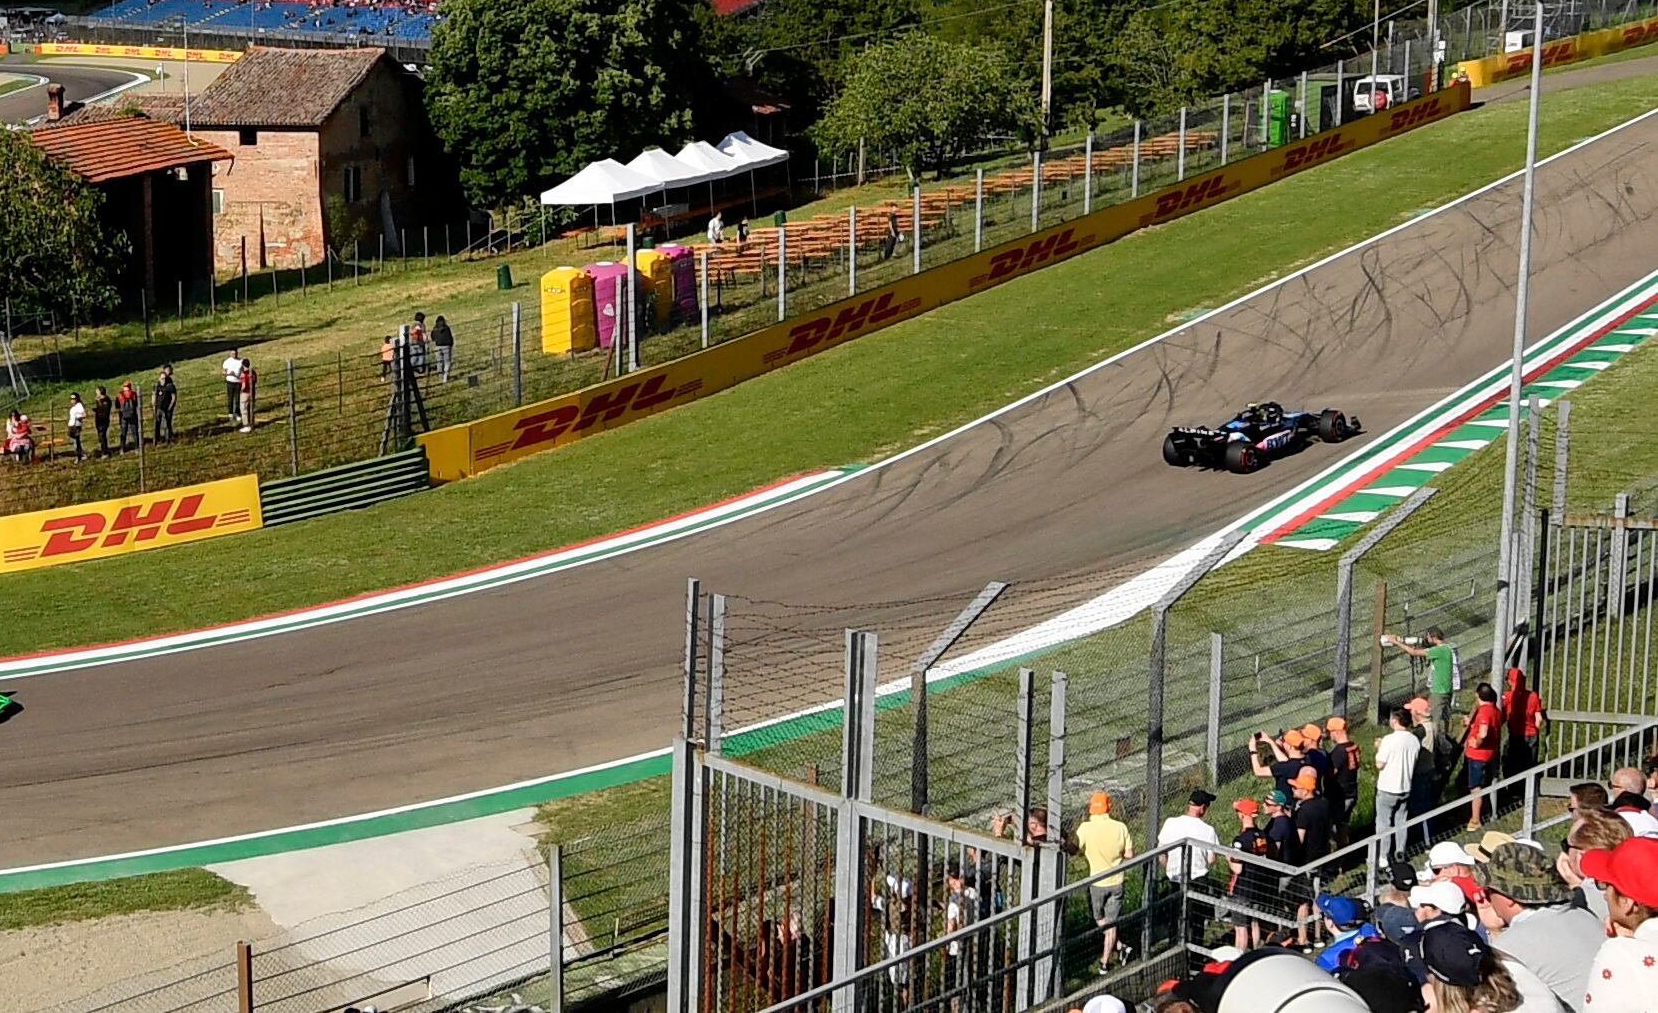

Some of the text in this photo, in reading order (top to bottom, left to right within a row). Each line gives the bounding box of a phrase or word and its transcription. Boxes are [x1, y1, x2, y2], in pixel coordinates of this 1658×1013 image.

[1390, 98, 1441, 132] DHL
[1283, 133, 1344, 168] DHL
[1155, 175, 1228, 217] DHL
[989, 229, 1080, 280] DHL
[786, 292, 902, 357] DHL
[510, 375, 677, 450] DHL
[39, 494, 218, 558] DHL
